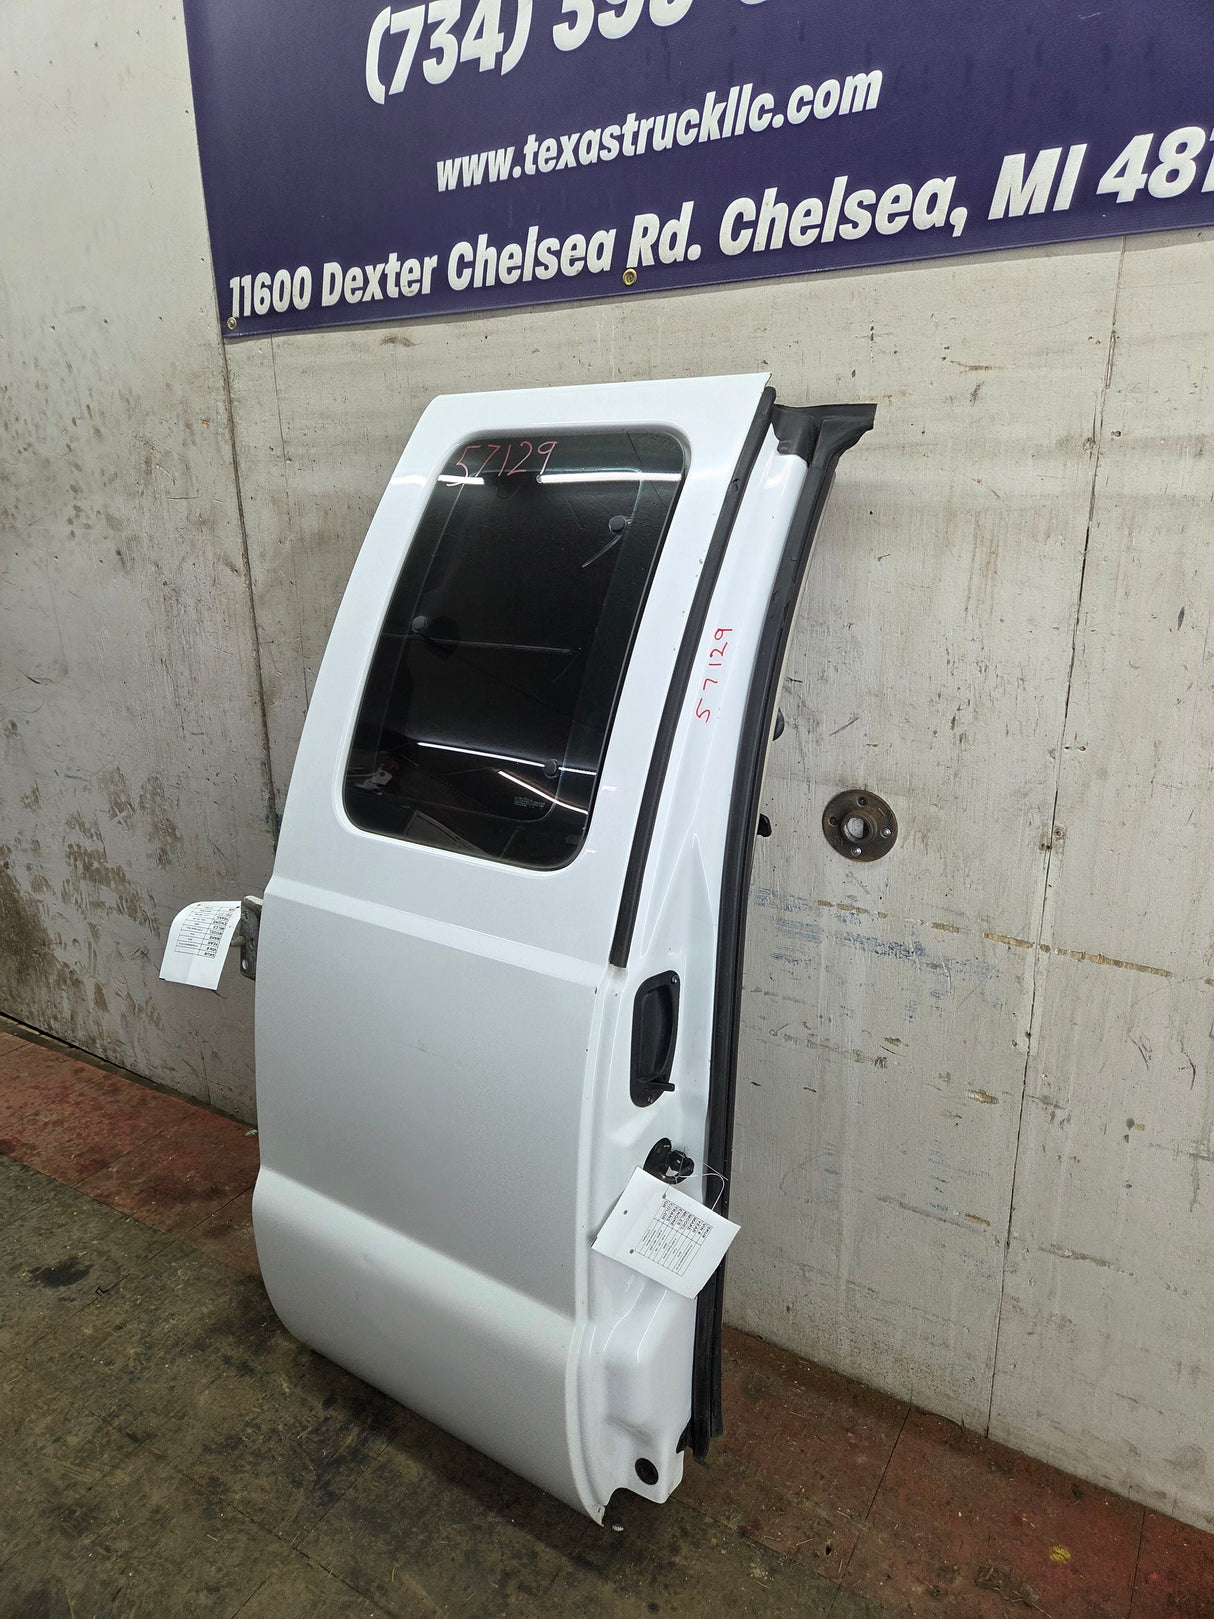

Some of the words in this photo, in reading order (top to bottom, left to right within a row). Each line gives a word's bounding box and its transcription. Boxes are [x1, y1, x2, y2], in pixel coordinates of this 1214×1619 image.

[366, 0, 532, 105] (734)
[436, 69, 884, 192] www.texastruckllc.com
[228, 265, 313, 319] 11600
[321, 252, 438, 307] Dexter
[447, 226, 617, 291] Chelsea
[626, 201, 702, 268] Rd.
[719, 176, 968, 257] Chelsea,
[988, 143, 1088, 221] MI
[446, 441, 558, 486] 57129
[696, 628, 733, 723] 57129
